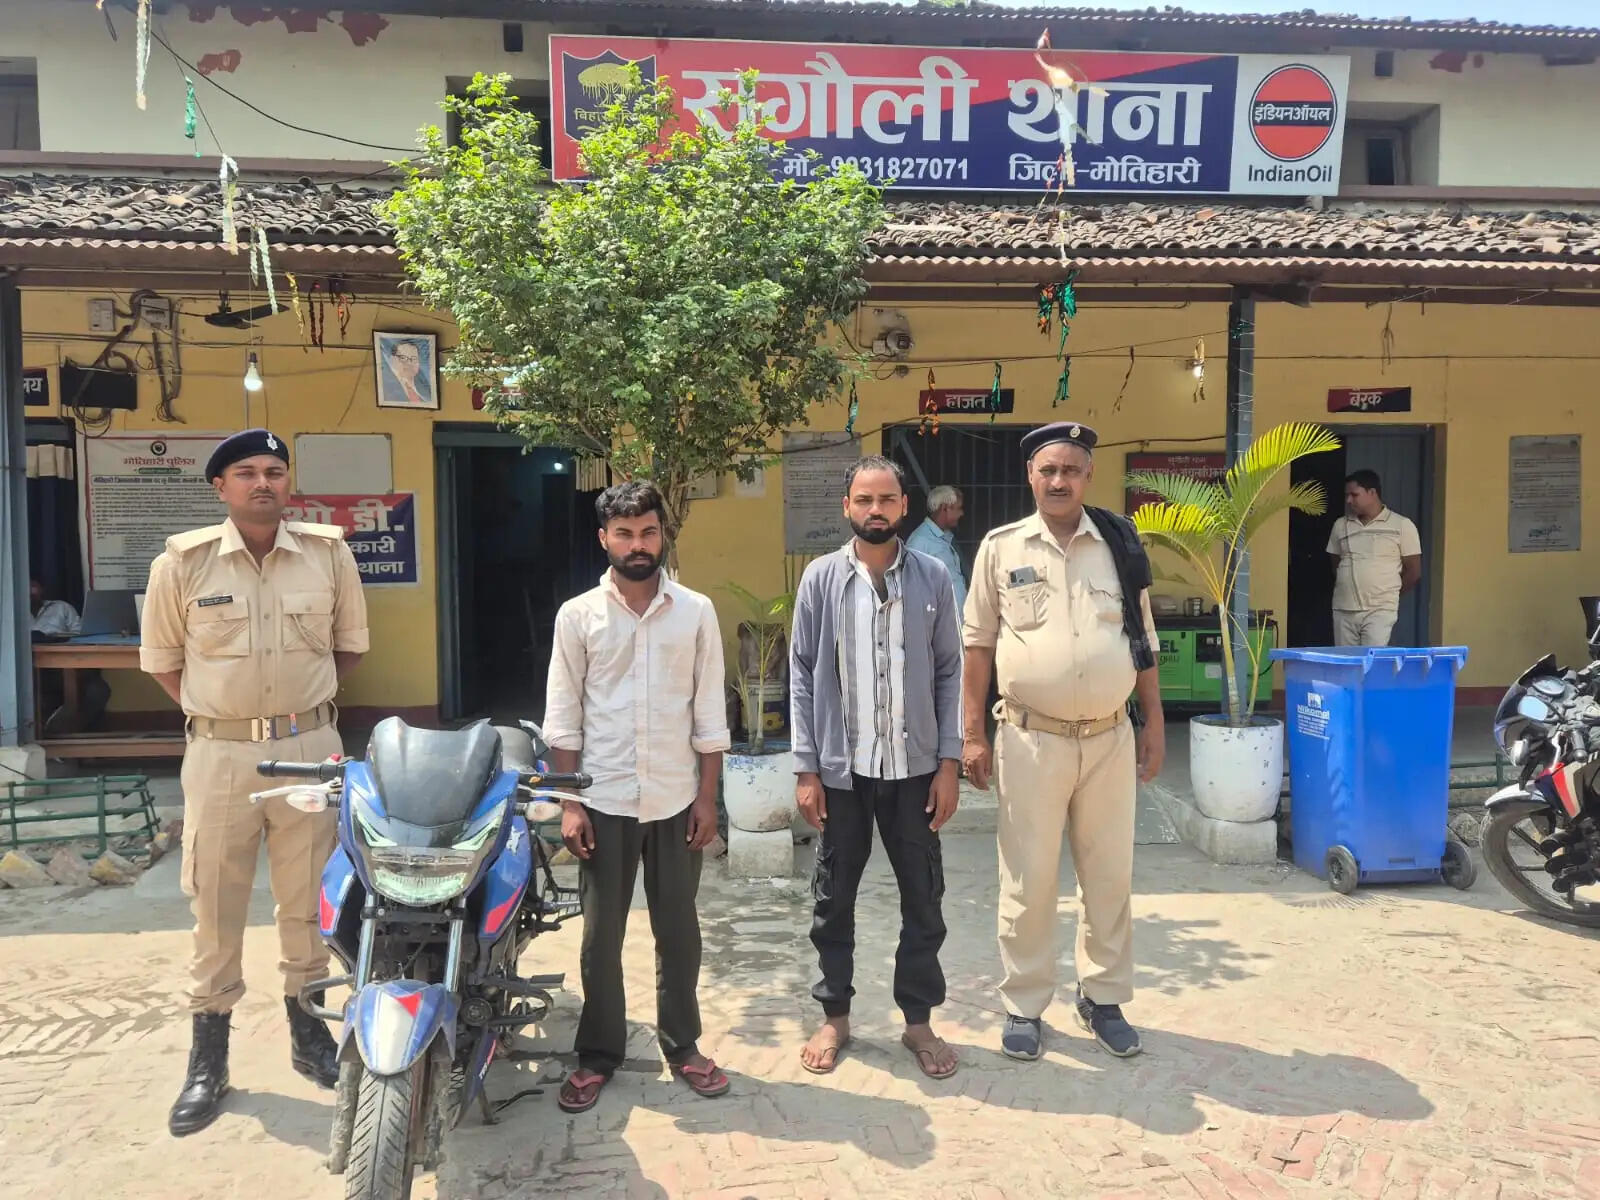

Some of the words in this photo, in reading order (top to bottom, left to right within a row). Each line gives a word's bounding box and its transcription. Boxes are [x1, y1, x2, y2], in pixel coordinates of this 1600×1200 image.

[1008, 78, 1212, 145] थाना
[1254, 103, 1332, 123] इंडियनऑयल
[1248, 164, 1332, 182] IndianOil
[945, 394, 989, 409] हाजत
[348, 535, 396, 554] कारी
